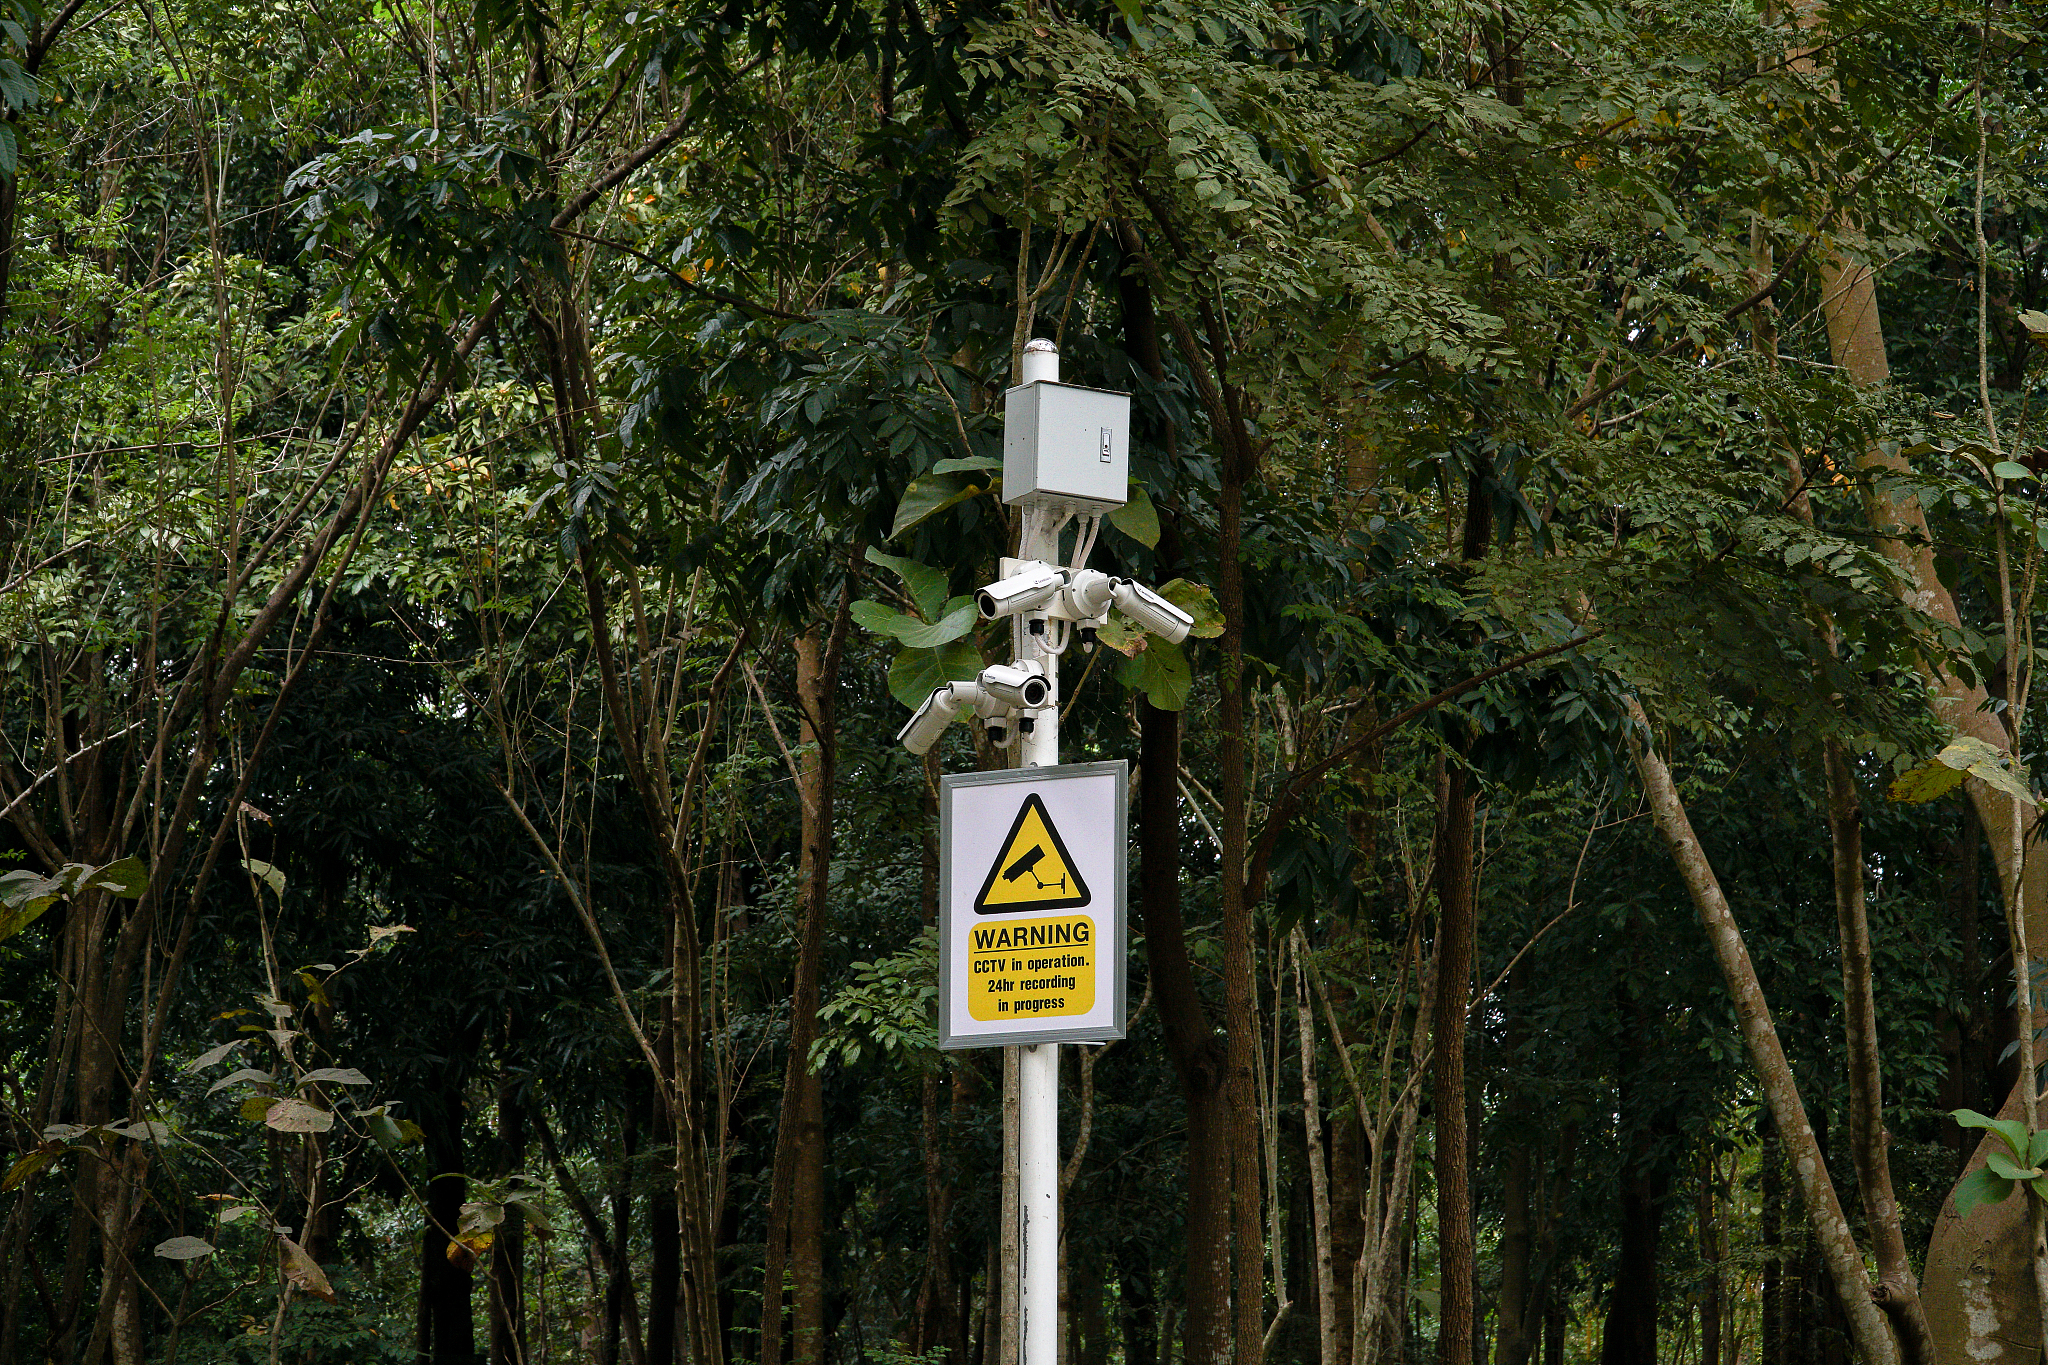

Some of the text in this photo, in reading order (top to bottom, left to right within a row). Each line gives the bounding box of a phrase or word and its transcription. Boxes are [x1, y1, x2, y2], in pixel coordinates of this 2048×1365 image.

[974, 922, 1089, 950] WARNING
[974, 954, 1090, 974] CCTV in operation.
[987, 975, 1076, 993] 24hr recording
[998, 997, 1065, 1014] in progress
